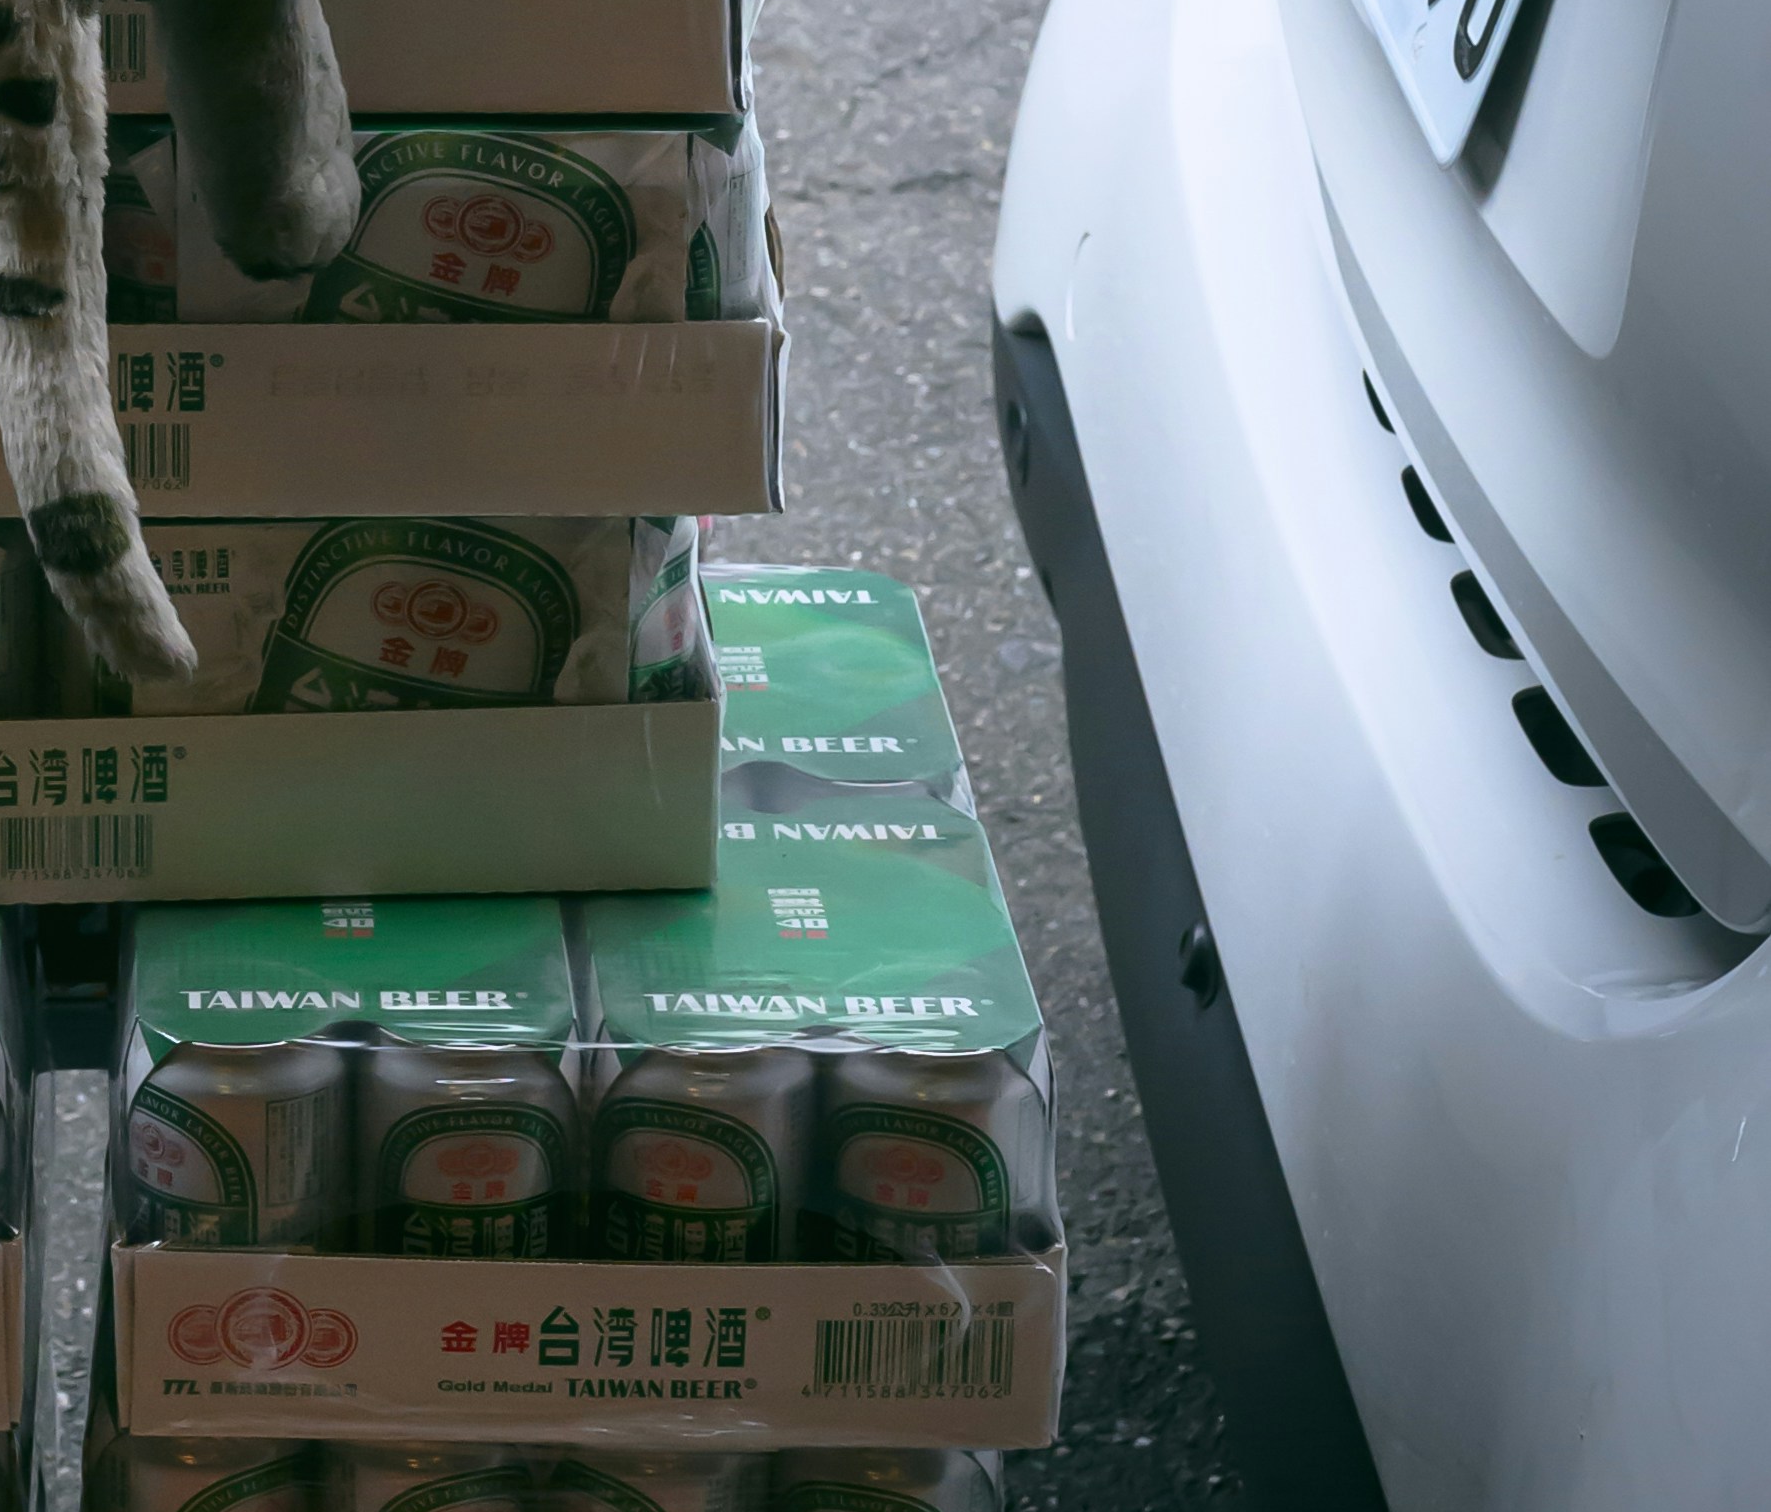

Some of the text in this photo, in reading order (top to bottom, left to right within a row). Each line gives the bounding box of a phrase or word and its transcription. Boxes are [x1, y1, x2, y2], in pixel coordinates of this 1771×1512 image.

[461, 143, 566, 189] FLAVOR
[571, 184, 622, 246] LAGER
[285, 531, 396, 629] DISTINCTIVE
[407, 531, 510, 571] FLAVOR
[719, 589, 880, 606] TAIWAN
[379, 636, 470, 679] 金牌
[781, 736, 905, 754] BEER
[773, 822, 947, 841] TAIWAN
[179, 988, 514, 1012] TAIWAN BEER
[642, 992, 980, 1018] TAIWAN BEER
[139, 1091, 179, 1121] LAVOR
[440, 1319, 531, 1355] 金牌
[437, 1378, 743, 1400] Gold Medal TAIWAN BEER
